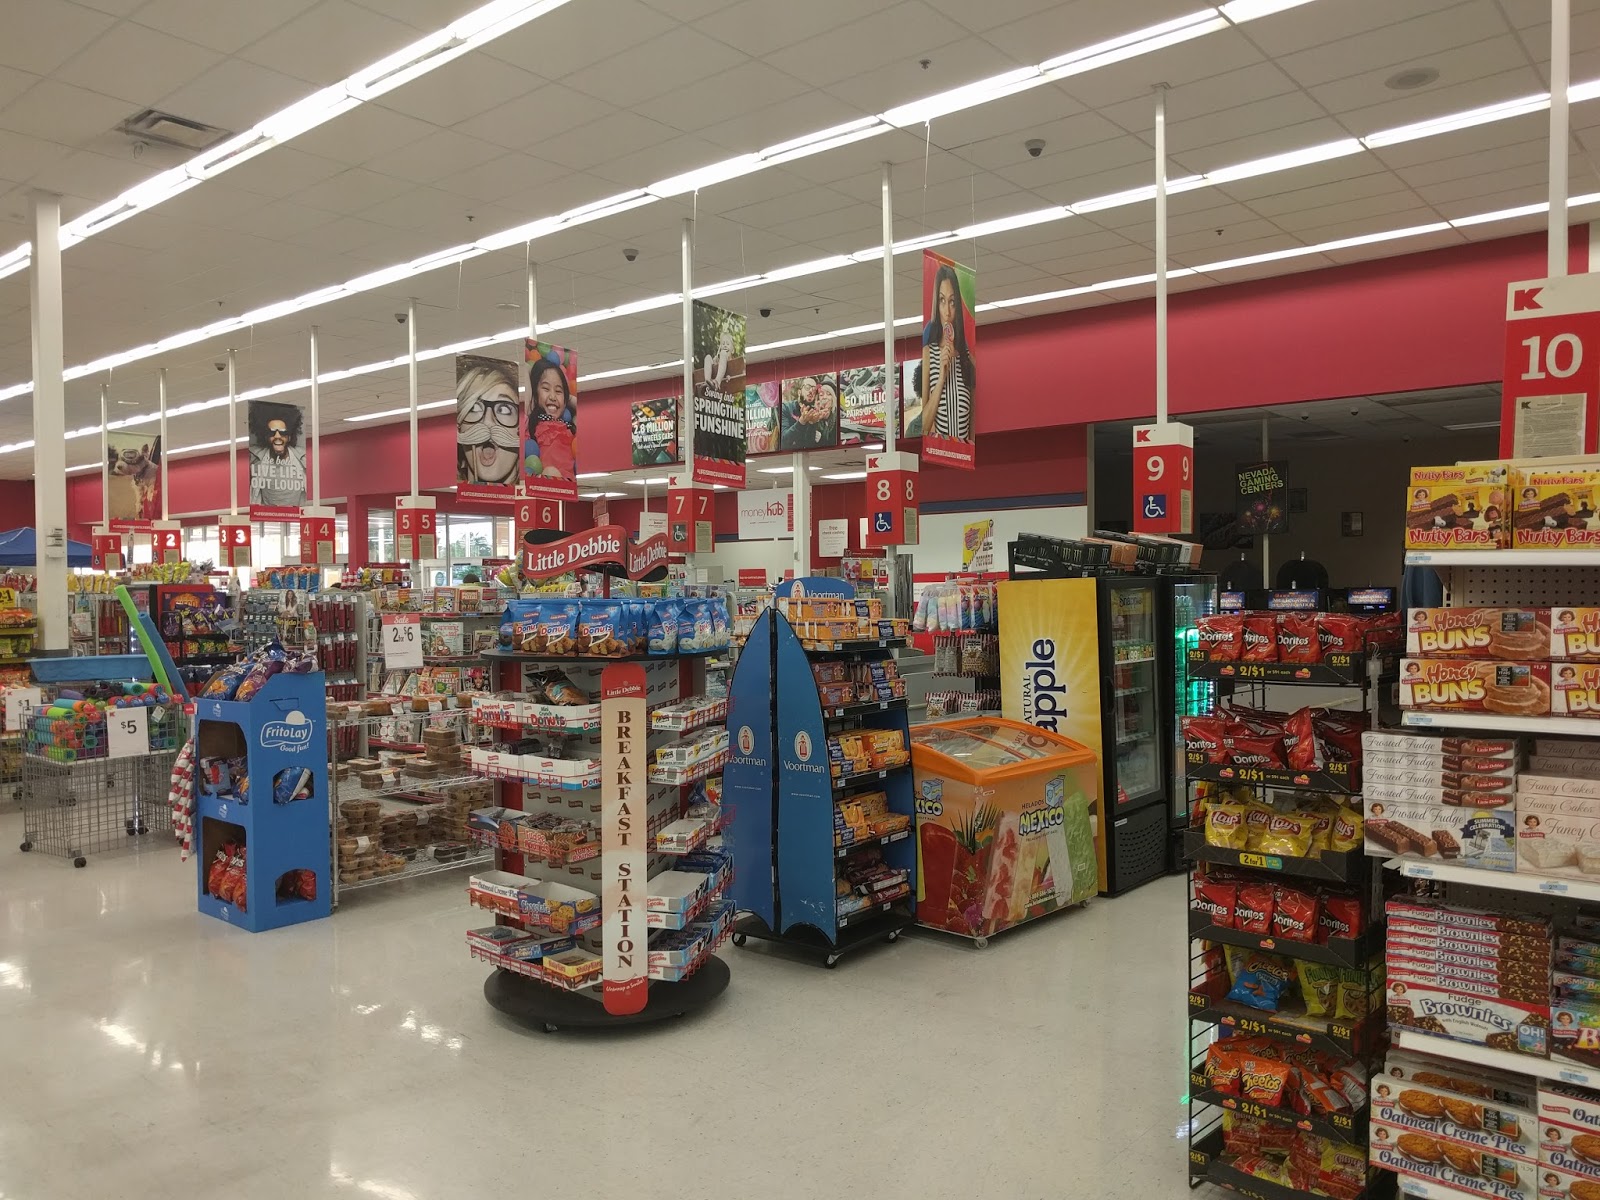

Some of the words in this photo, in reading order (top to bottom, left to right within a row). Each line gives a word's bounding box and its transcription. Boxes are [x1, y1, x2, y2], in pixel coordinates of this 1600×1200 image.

[1513, 287, 1544, 311] K
[1521, 333, 1583, 380] 10
[845, 396, 856, 407] 50
[859, 392, 886, 406] MILLIO
[695, 397, 744, 421] SPRINGTIME
[746, 407, 772, 420] ILLION
[846, 409, 863, 417] PAIRS
[873, 405, 886, 414] SHO
[646, 420, 673, 433] MILLION
[695, 413, 744, 439] FUNSHINE
[746, 421, 767, 429] LLIPOPS
[662, 432, 673, 440] CARS
[1136, 429, 1150, 442] K
[868, 458, 879, 468] K
[1147, 456, 1164, 481] 9
[1183, 456, 1188, 481] 9
[252, 464, 276, 478] LIVE
[280, 466, 304, 479] LIFE
[1238, 467, 1276, 481] NEVADA
[1414, 471, 1441, 481] Nutty
[1442, 470, 1465, 480] Bars
[251, 478, 271, 489] OUT
[274, 478, 305, 491] LOUD!
[670, 477, 677, 486] K
[1239, 473, 1278, 488] GAMING
[1240, 479, 1284, 495] CENTERS
[876, 479, 891, 500] 8
[906, 479, 913, 500] 8
[675, 496, 684, 514] 7
[699, 497, 707, 515] 7
[521, 505, 529, 522] 6
[542, 507, 551, 523] 6
[304, 523, 310, 536] 4
[320, 523, 329, 536] 4
[402, 515, 410, 530] 5
[422, 515, 430, 530] 5
[153, 534, 158, 546] 2
[166, 533, 176, 547] 2
[221, 530, 227, 543] 3
[235, 529, 245, 543] 3
[1409, 528, 1452, 546] Nutty
[1453, 527, 1491, 544] Bars
[1517, 528, 1564, 547] Nutty
[1564, 527, 1600, 544] Bars
[95, 539, 99, 550] 1
[108, 539, 115, 550] 1
[527, 550, 565, 571] Little
[567, 534, 621, 563] Debbie
[629, 551, 646, 574] Little
[647, 540, 667, 569] Debbie
[806, 590, 845, 600] Voortman
[393, 616, 409, 624] Sale
[1433, 611, 1484, 632] Honey
[392, 627, 399, 643] 2
[404, 626, 413, 642] $6
[540, 624, 570, 636] Donuts
[583, 623, 614, 636] Donuts
[1200, 632, 1234, 642] Doritos
[1277, 634, 1309, 645] Doritos
[1318, 633, 1343, 646] oritos
[1420, 626, 1491, 651] BUNS
[1189, 651, 1205, 659] 2/$1
[1332, 656, 1350, 664] 2/$1
[1240, 666, 1265, 677] 2/$1
[1426, 663, 1478, 684] Honey
[606, 688, 621, 696] Little
[621, 685, 641, 695] Debbie
[1026, 638, 1067, 733] apple
[1413, 680, 1486, 704] BUNS
[18, 699, 32, 711] $1
[1023, 675, 1032, 724] ATURAL
[477, 708, 511, 722] Donuts
[530, 714, 566, 727] Donuts
[121, 720, 137, 734] $5
[280, 743, 296, 753] Good
[296, 742, 309, 754] fun!
[1233, 754, 1271, 764] Doritos
[783, 760, 825, 774] Voortman
[1329, 763, 1347, 771] 2/$1
[617, 710, 632, 846] BREAKFAST
[1239, 769, 1264, 781] 2/$1
[1526, 778, 1561, 795] Fancy
[1562, 781, 1597, 795] Cakes
[1366, 785, 1402, 799] Frosted
[1405, 788, 1436, 803] Fudge
[916, 800, 943, 816] XICO
[1021, 800, 1045, 810] HELADOS
[1019, 806, 1064, 836] MEXICO
[1385, 803, 1428, 821] Frosted
[1429, 807, 1464, 827] Fudge
[1269, 817, 1301, 834] Lay's
[1545, 817, 1587, 840] Fancy
[1244, 855, 1249, 863] 2
[478, 882, 494, 893] Oatmeal
[495, 885, 508, 896] Creme
[1195, 901, 1228, 915] Doritos
[617, 862, 634, 969] STATION
[1273, 913, 1304, 930] Doritos
[1412, 909, 1434, 918] Fudge
[1434, 911, 1496, 930] Brownies
[1319, 916, 1349, 932] Doritos
[1248, 960, 1289, 981] Cheetos
[1557, 976, 1587, 987] COSMIC
[1448, 993, 1481, 1006] Fudge
[1420, 998, 1513, 1032] Brownies
[1241, 1019, 1266, 1033] 2/$1
[1332, 1025, 1350, 1036] 2/$1
[1520, 1025, 1544, 1037] OH!
[1242, 1072, 1282, 1092] Cheetos
[1241, 1103, 1267, 1117] 2/$1
[1380, 1107, 1439, 1132] Oatmeal
[1441, 1123, 1488, 1145] Creme
[1490, 1135, 1526, 1155] Pies
[1550, 1152, 1600, 1176] Oatme
[1379, 1150, 1438, 1178] Oatmeal
[1440, 1168, 1487, 1191] Creme
[1489, 1180, 1525, 1200] Pies
